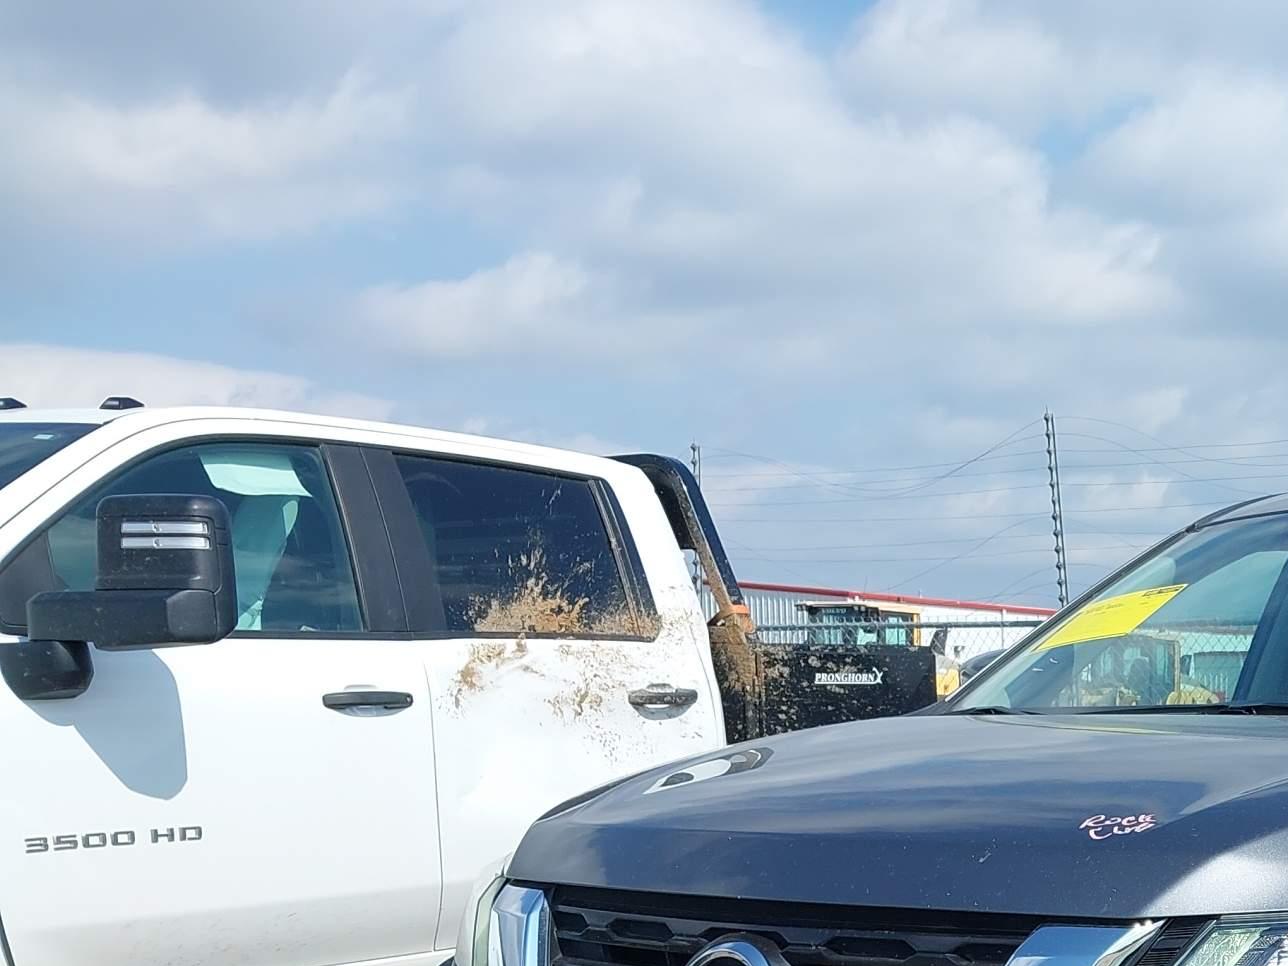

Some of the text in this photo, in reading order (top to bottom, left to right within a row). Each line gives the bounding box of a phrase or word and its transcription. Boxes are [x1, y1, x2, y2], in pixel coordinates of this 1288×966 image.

[815, 670, 880, 684] PRONGHORN
[24, 826, 203, 854] 3500 HD
